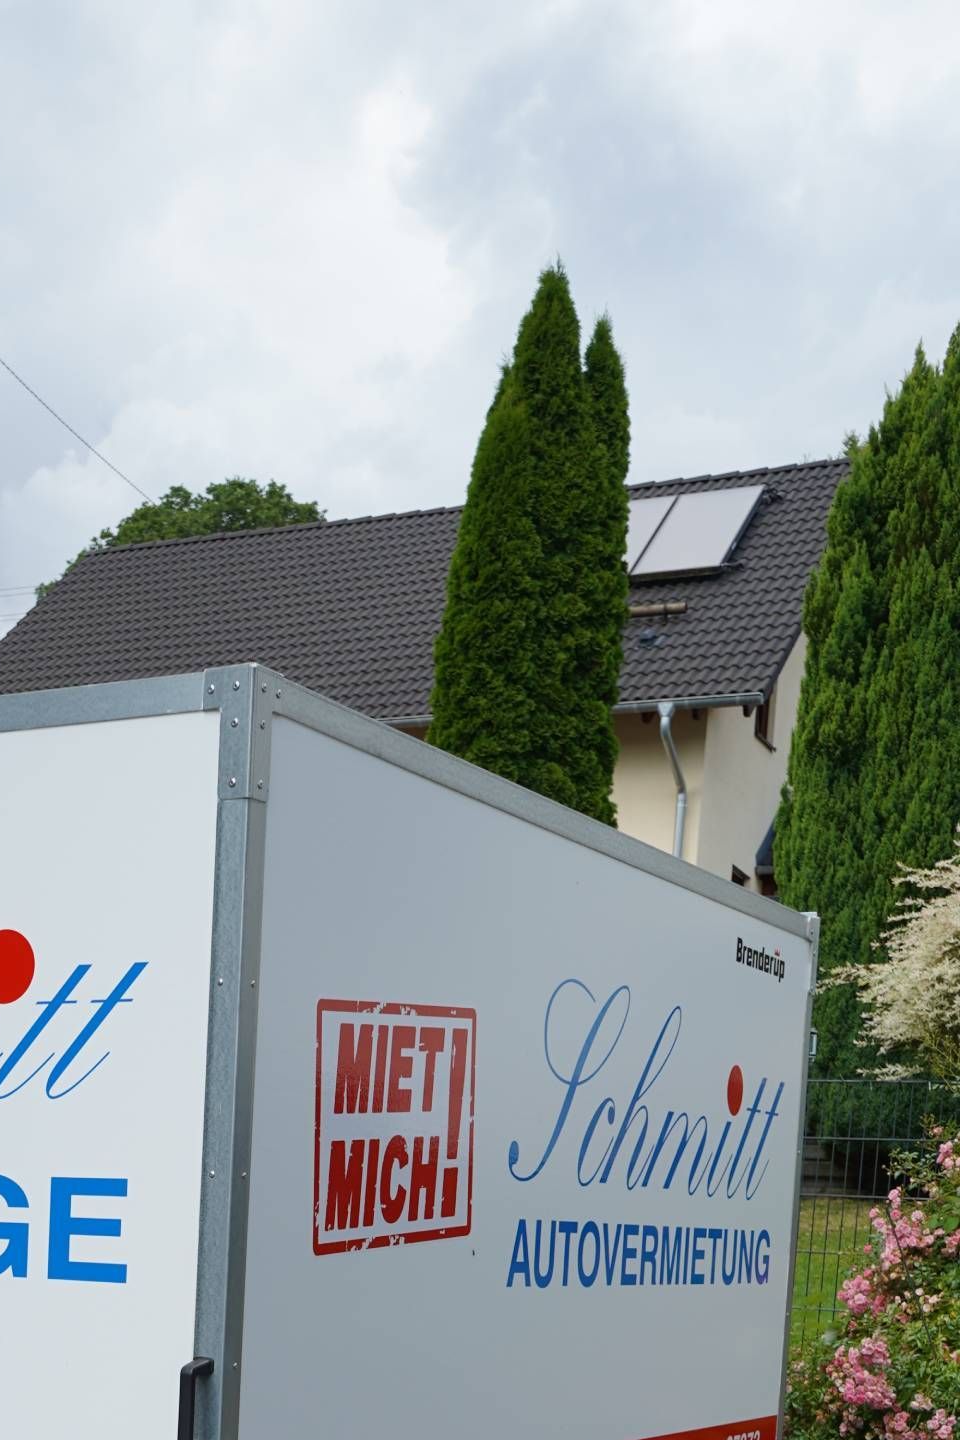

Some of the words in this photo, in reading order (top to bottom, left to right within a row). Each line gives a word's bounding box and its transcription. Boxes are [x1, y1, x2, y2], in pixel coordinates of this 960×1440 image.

[736, 937, 785, 983] Brenderup
[334, 1023, 445, 1114] MIET
[507, 978, 785, 1200] Schmitt
[506, 1218, 771, 1288] AUTOVERMIETUNG
